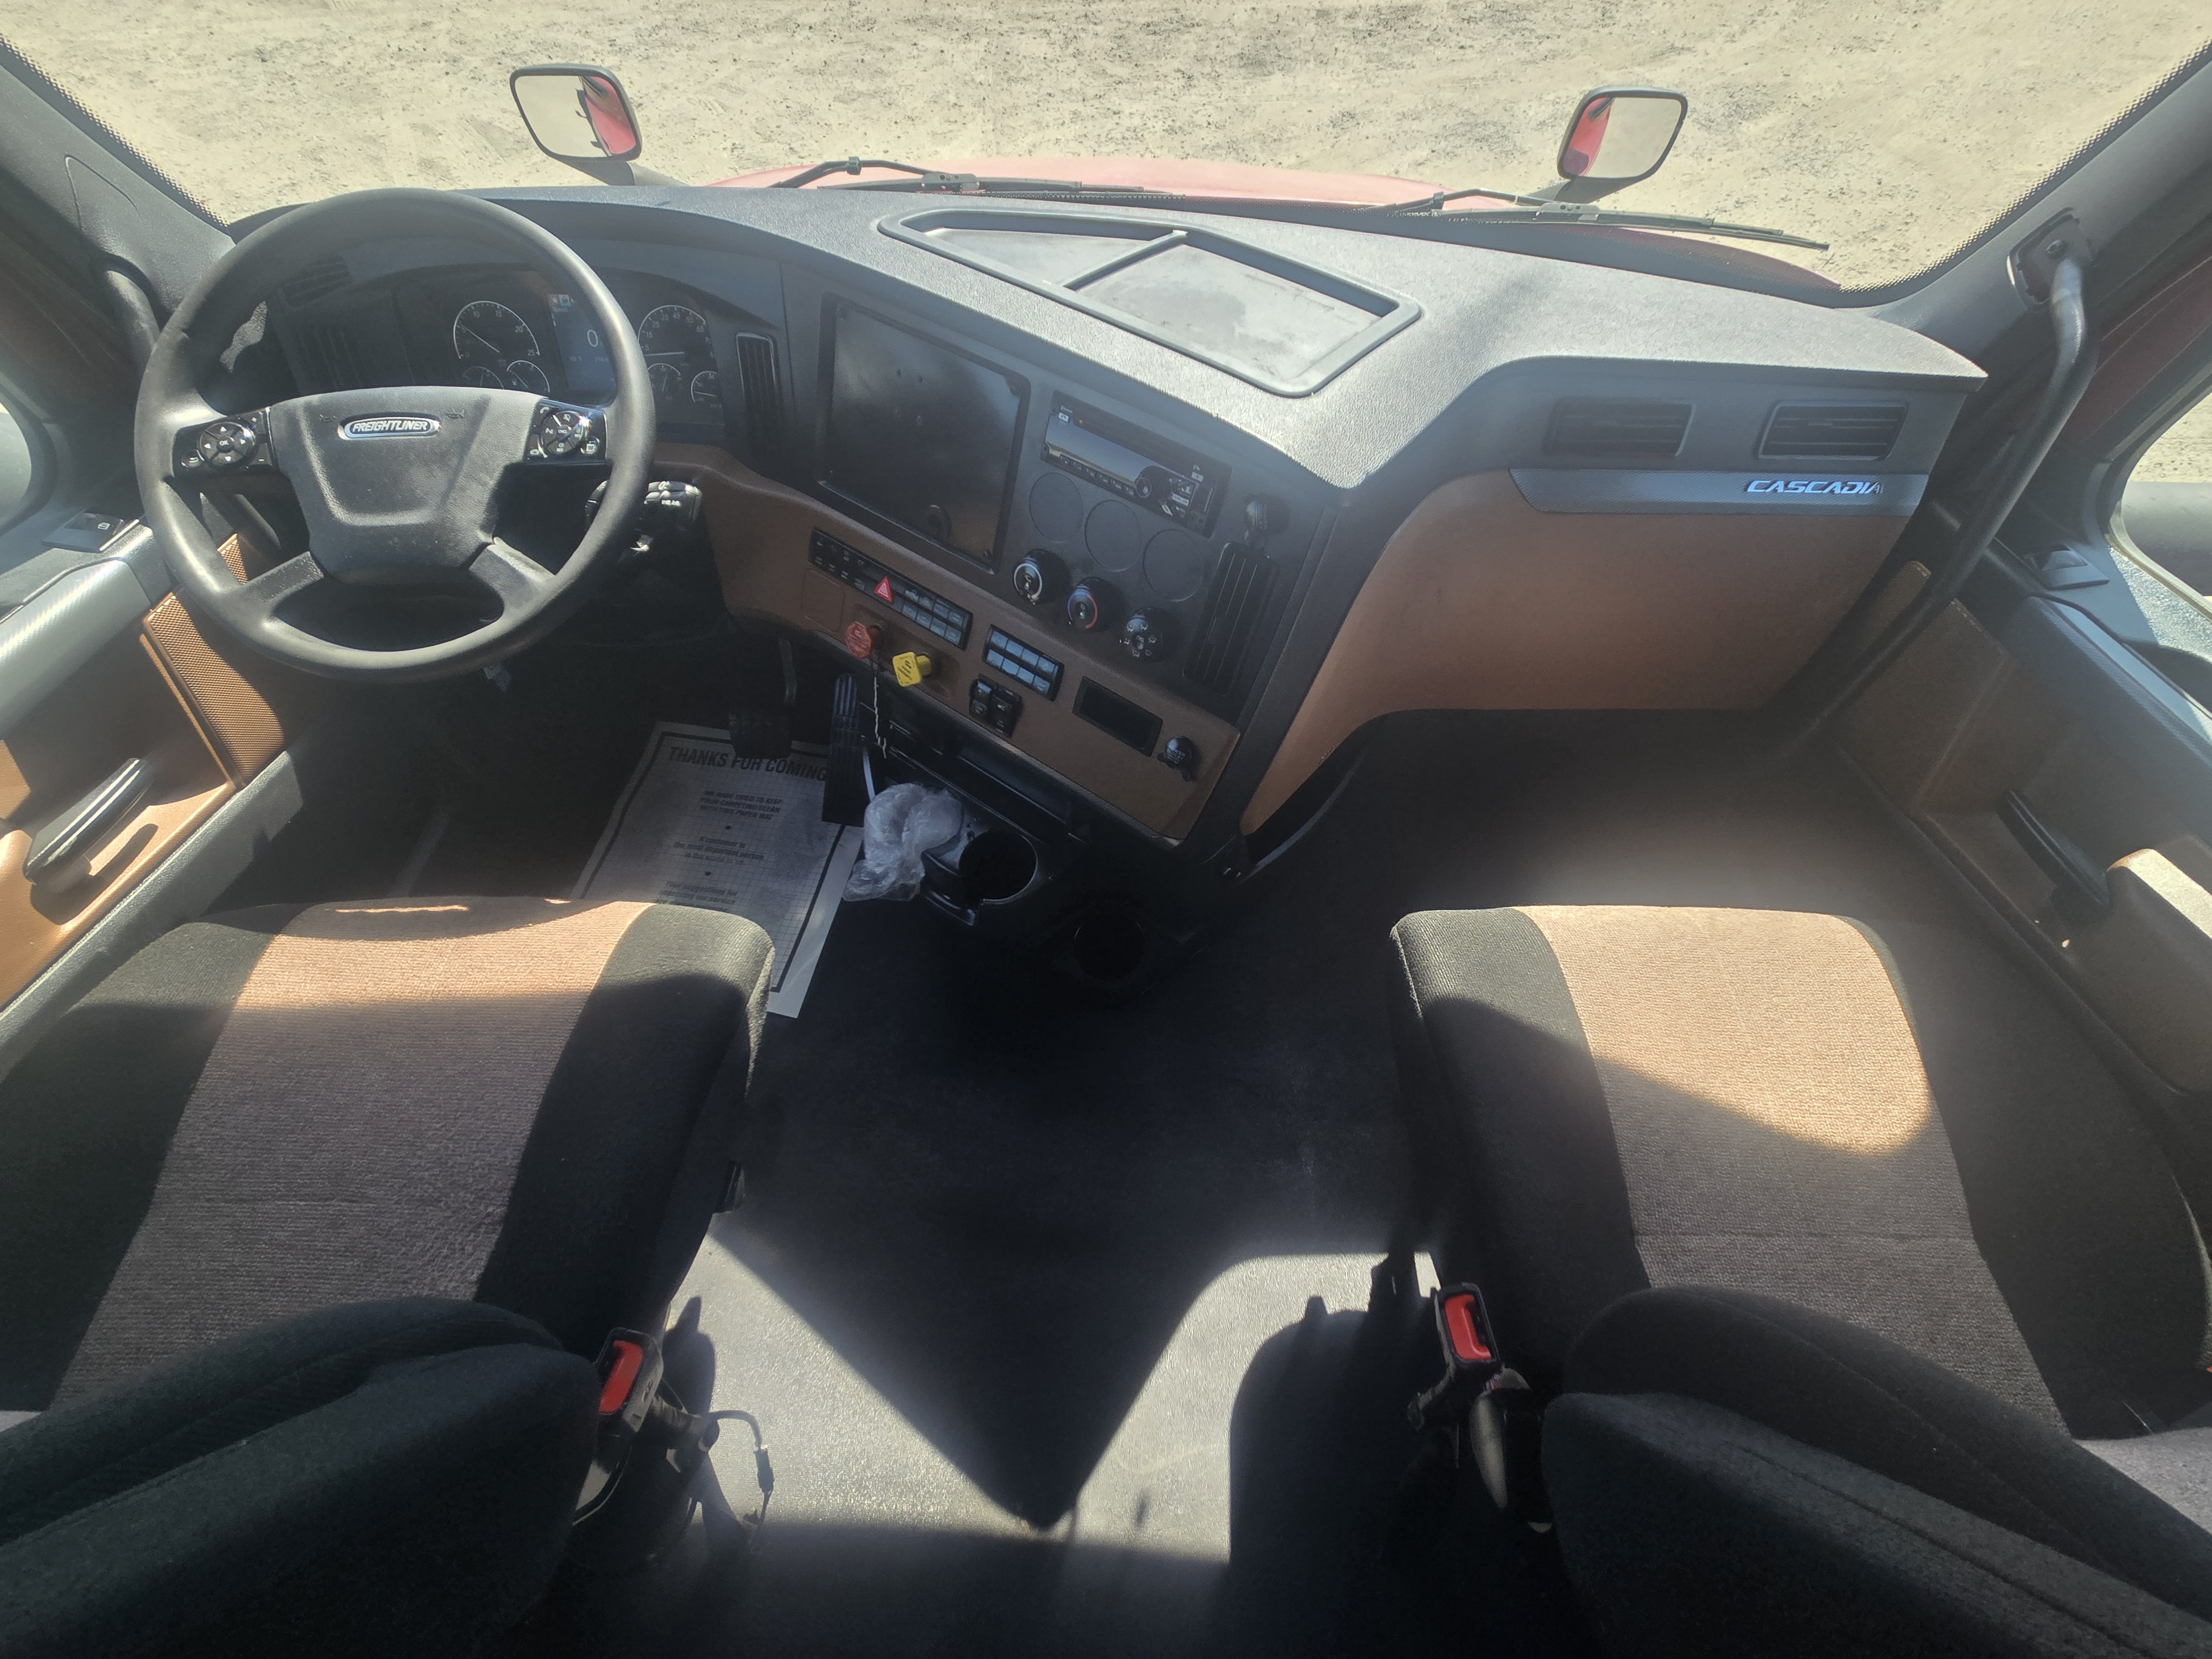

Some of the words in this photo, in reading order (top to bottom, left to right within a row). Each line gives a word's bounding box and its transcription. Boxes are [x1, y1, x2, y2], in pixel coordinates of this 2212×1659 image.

[352, 420, 428, 432] FREIGHTLINER
[1747, 480, 1884, 494] CASCADIA
[1166, 748, 1184, 761] OUTLET
[669, 747, 729, 767] THANKS
[731, 756, 763, 771] FOR
[764, 758, 827, 780] COMING
[735, 810, 758, 818] PAPER
[758, 805, 781, 813] CLEAN
[665, 880, 682, 888] Your
[682, 883, 726, 895] suggestions
[658, 888, 695, 901] improving
[708, 896, 737, 905] service
